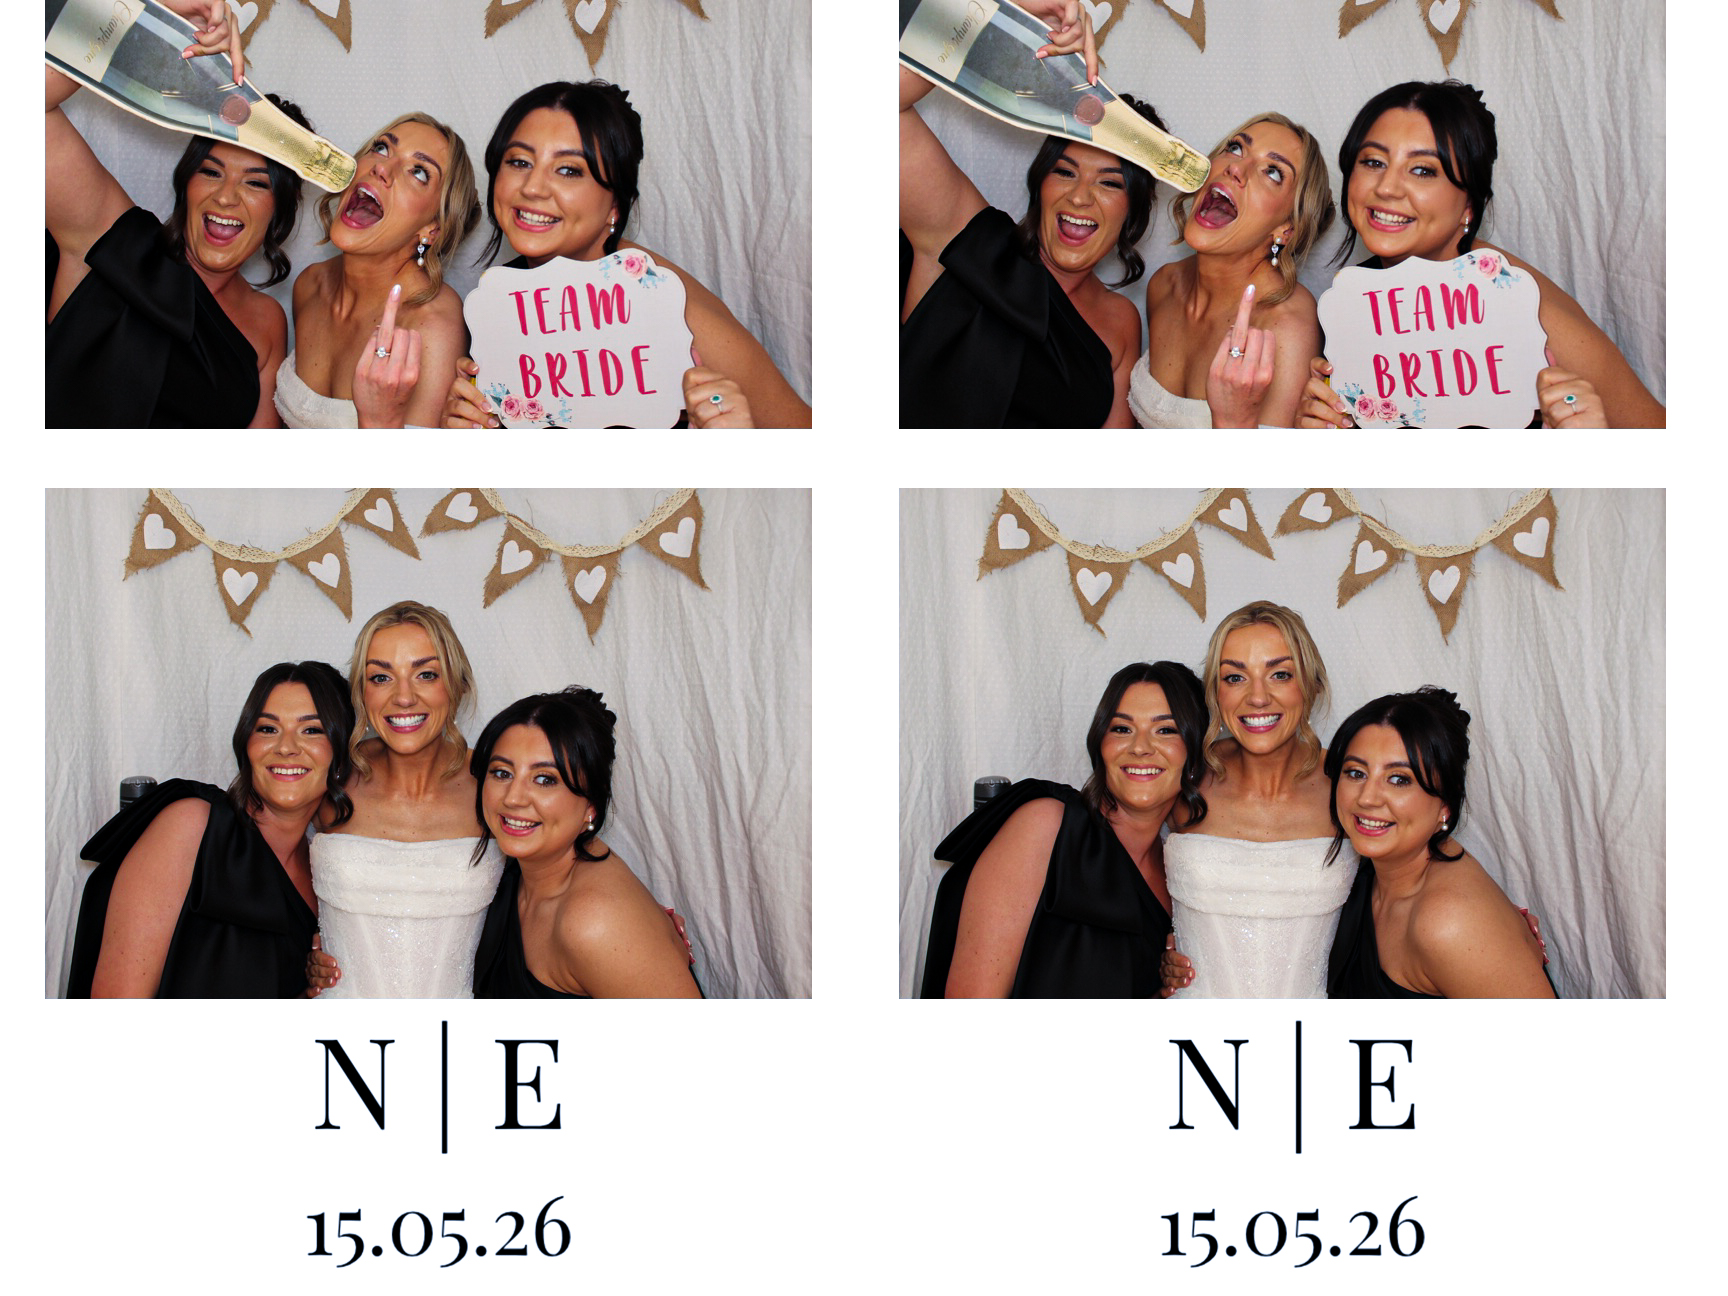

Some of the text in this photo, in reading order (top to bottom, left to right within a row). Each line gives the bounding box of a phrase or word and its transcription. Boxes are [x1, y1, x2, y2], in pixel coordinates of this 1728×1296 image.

[508, 283, 631, 336] TEAM
[1362, 283, 1485, 336] TEAM
[518, 345, 657, 399] BRIDE
[1372, 345, 1511, 399] BRIDE
